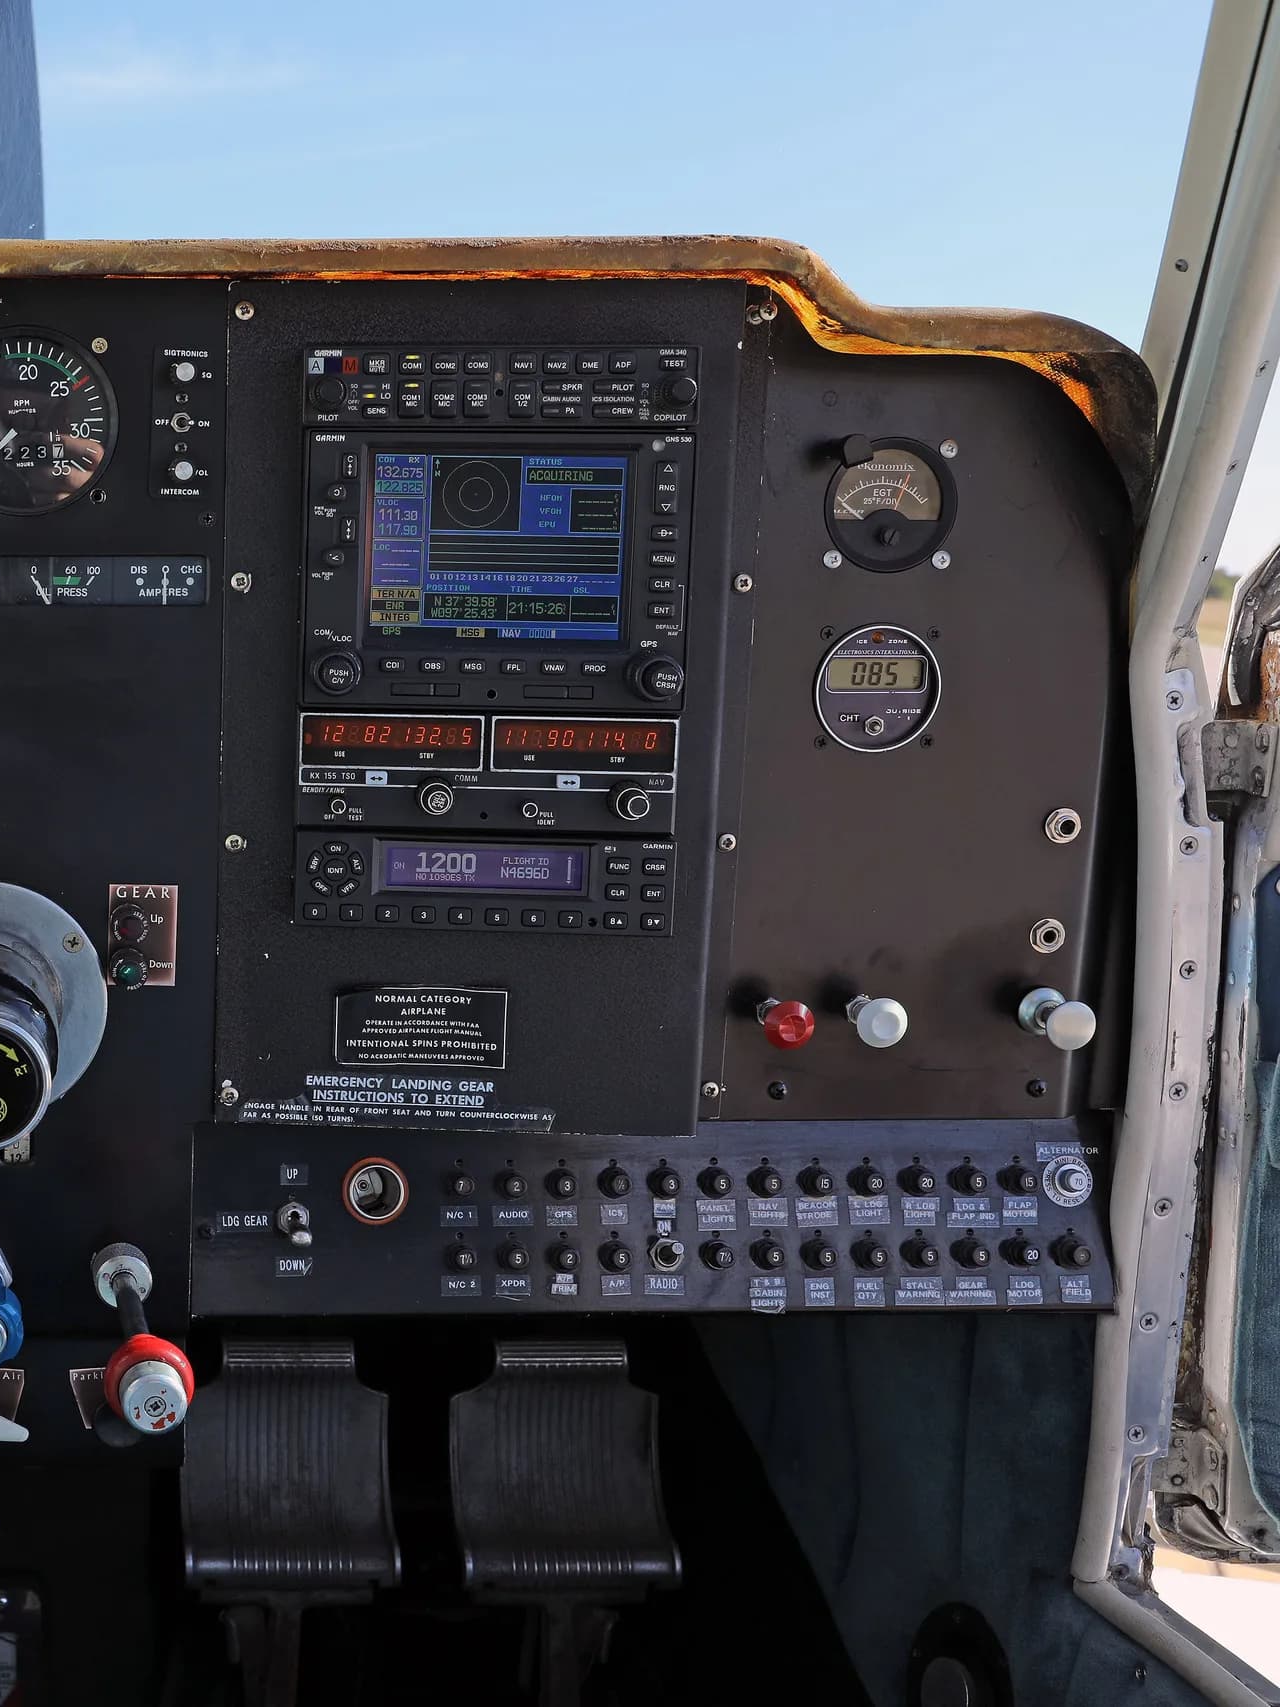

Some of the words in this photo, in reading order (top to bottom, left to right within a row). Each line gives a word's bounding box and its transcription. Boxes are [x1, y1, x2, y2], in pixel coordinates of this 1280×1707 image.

[164, 349, 208, 358] SIGTRONICS
[402, 362, 422, 370] COM1
[435, 362, 455, 370] COM2
[615, 361, 631, 369] ADF
[19, 365, 38, 380] 20
[50, 380, 69, 397] 25
[562, 383, 583, 391] SPKR
[611, 407, 633, 415] CREW
[70, 423, 90, 438] 30
[52, 460, 71, 476] 35
[377, 466, 423, 478] 132.675
[529, 470, 593, 482] ACQUIRING
[377, 481, 423, 493] 122.825
[658, 484, 675, 492] RNG
[873, 488, 892, 497] EGT
[378, 509, 418, 521] 111.30
[378, 524, 417, 536] 117.90
[130, 565, 147, 575] DIS
[180, 565, 202, 574] CHG
[57, 588, 88, 597] PRESS
[139, 588, 188, 597] AMPERES
[544, 664, 564, 672] VNAV
[851, 662, 898, 686] 085
[840, 713, 859, 722] CHT
[310, 772, 320, 780] KX
[323, 772, 336, 780] 155
[341, 772, 355, 780] TSO
[417, 853, 476, 873] 1200
[503, 856, 532, 865] FLIGHT
[500, 867, 549, 879] N4696D
[116, 886, 171, 900] GEAR
[150, 914, 164, 925] Up
[149, 959, 173, 969] Down
[375, 995, 417, 1003] NORMAL
[420, 995, 472, 1005] CATEGORY
[401, 1008, 446, 1016] AIRPLANE
[346, 1040, 409, 1048] INTENTIONAL
[412, 1040, 438, 1048] SPINS
[441, 1040, 497, 1051] PROHIBITED
[306, 1075, 383, 1088] EMERGENCY
[392, 1079, 451, 1090] LANDING
[459, 1080, 494, 1092] GEAR
[313, 1089, 404, 1103] INSTRUCTIONS
[412, 1092, 428, 1104] TO
[435, 1093, 484, 1105] EXTEND
[364, 1107, 388, 1115] FRONT
[460, 1112, 538, 1121] COUNTERCLOCKWISE
[1038, 1146, 1098, 1154] ALTERNATOR
[287, 1168, 298, 1179] UP
[1009, 1201, 1031, 1209] FLAP
[1004, 1210, 1036, 1218] MOTOR
[222, 1215, 239, 1226] LDG
[244, 1214, 268, 1226] GEAR
[279, 1260, 305, 1271] DOWN
[501, 1279, 526, 1287] XPDR
[650, 1277, 678, 1289] RADIO
[856, 1282, 880, 1290] FUEL
[906, 1281, 934, 1289] STALL
[898, 1291, 940, 1299] WARNING
[1009, 1290, 1041, 1298] MOTOR
[2, 1372, 21, 1380] Air
